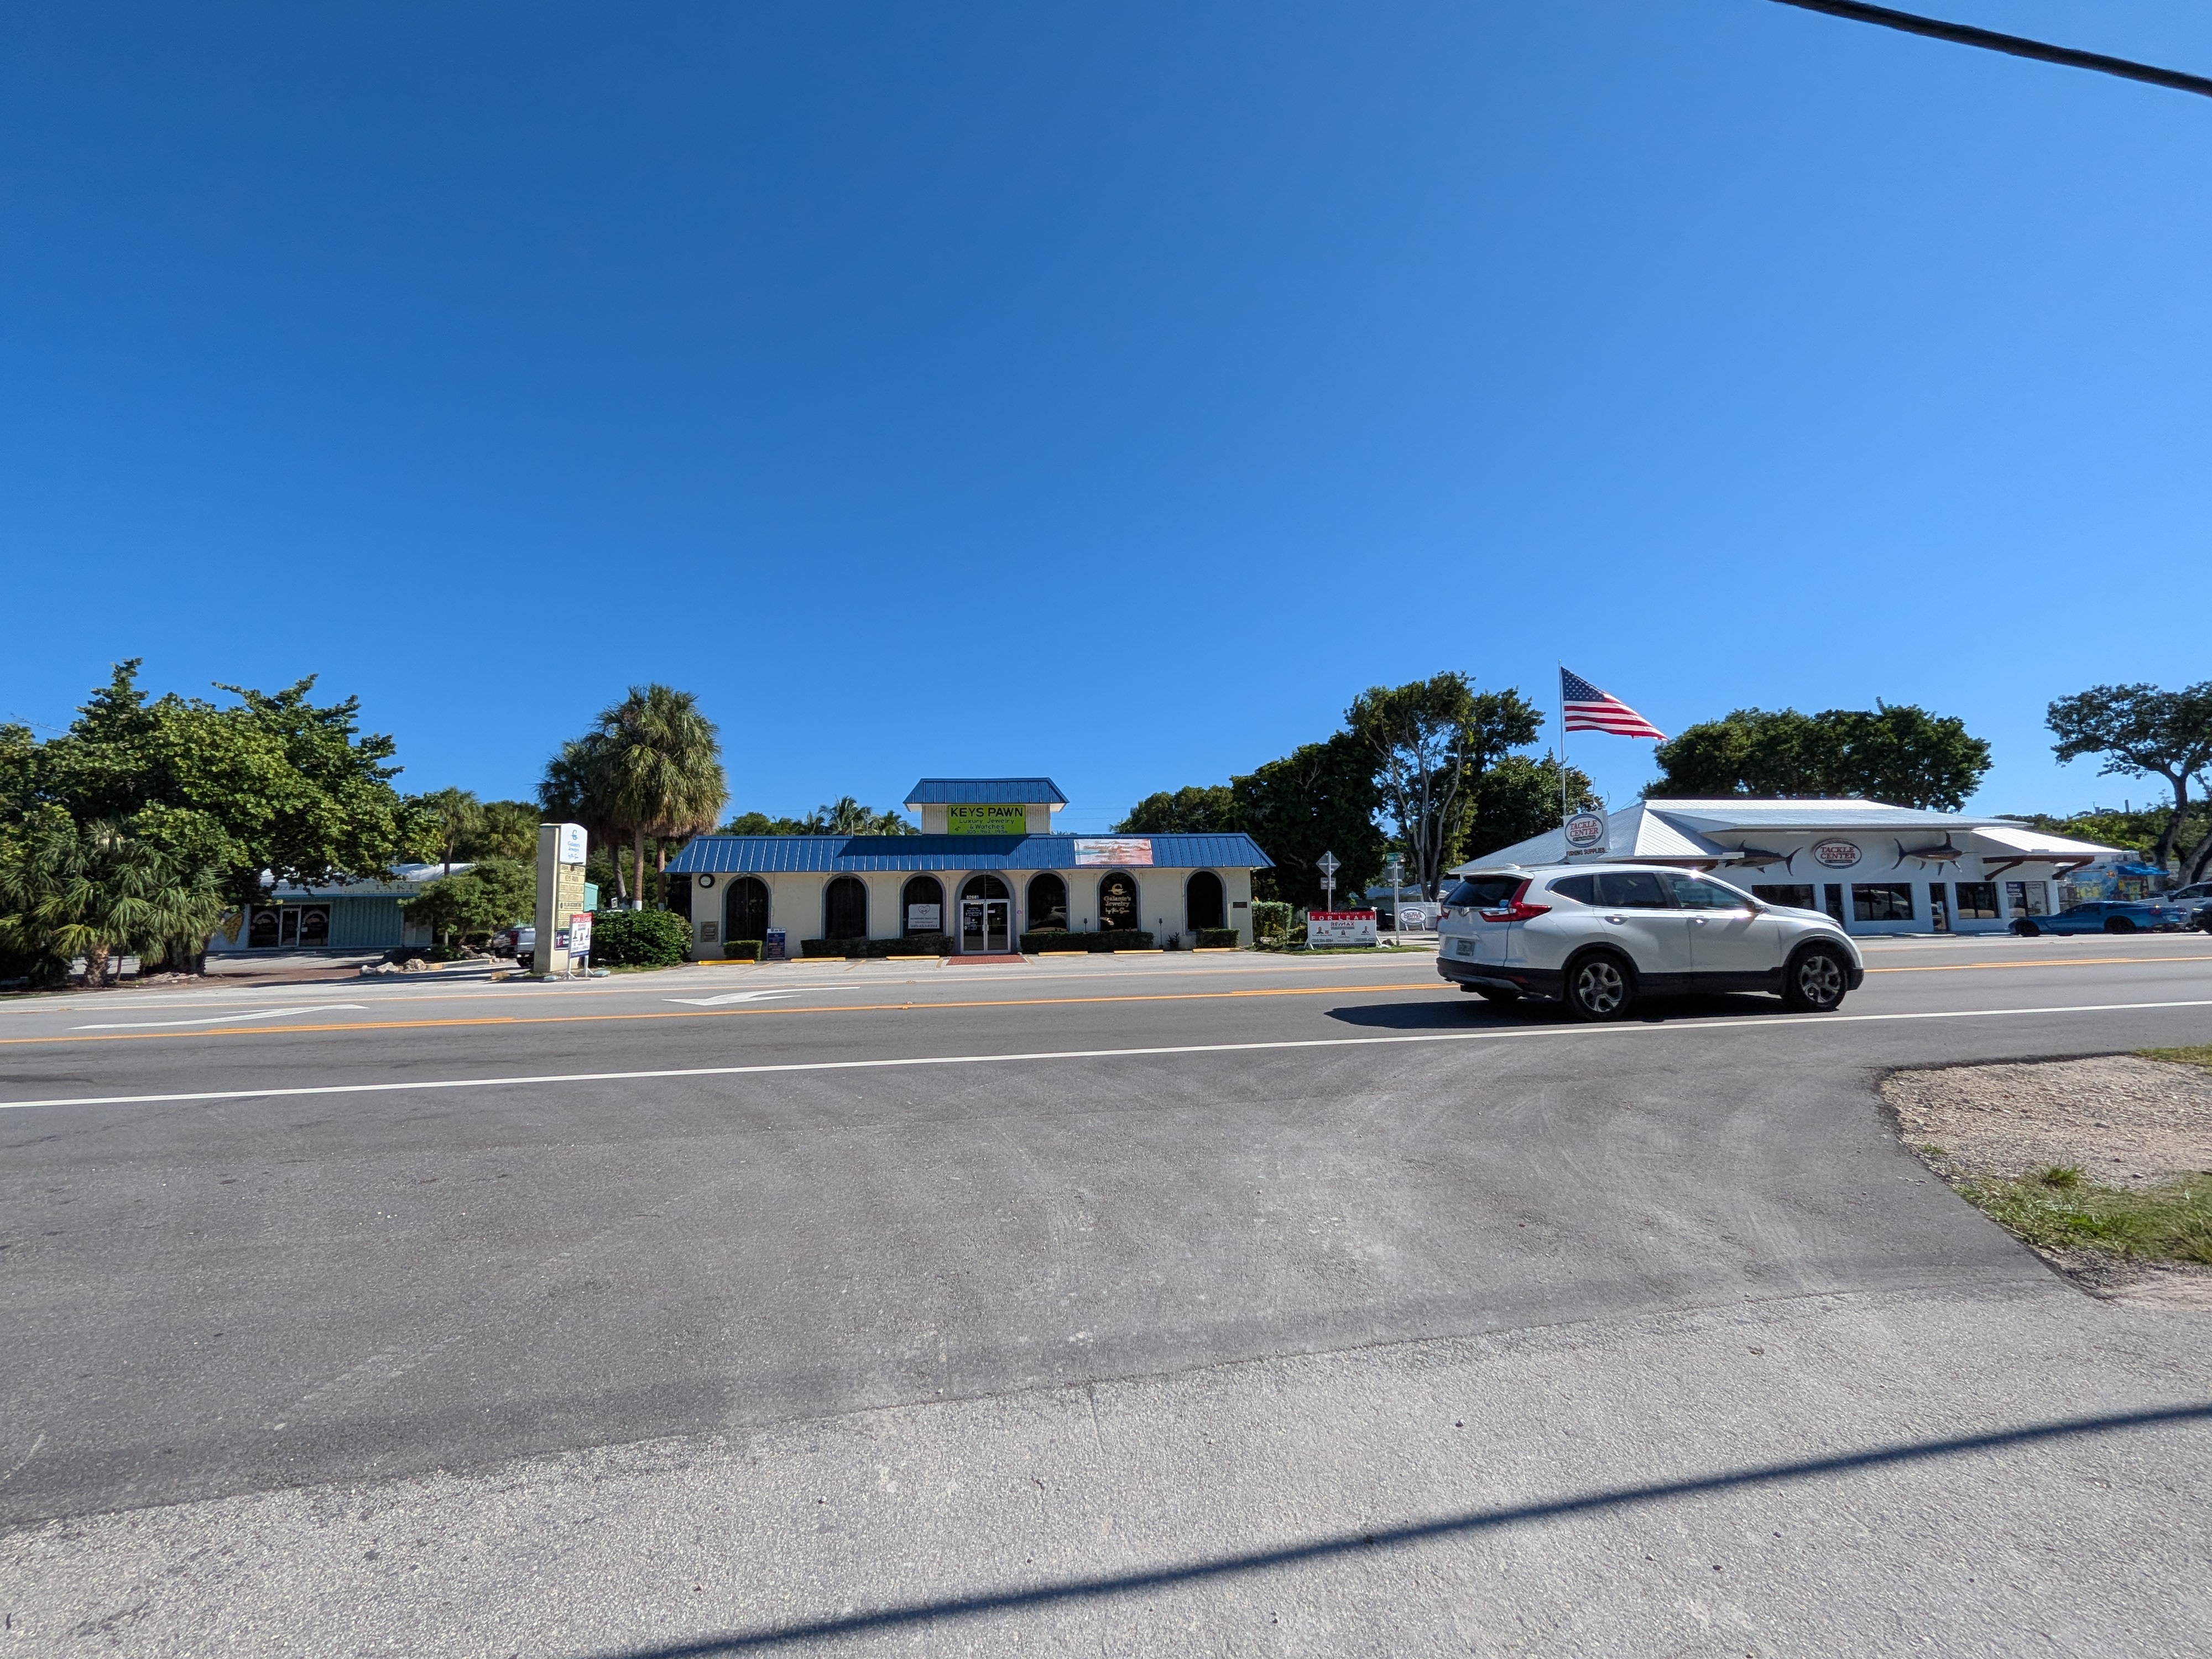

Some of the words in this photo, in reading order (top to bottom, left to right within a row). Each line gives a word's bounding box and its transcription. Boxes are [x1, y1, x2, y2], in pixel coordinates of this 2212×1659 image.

[951, 807, 984, 817] KEYS
[988, 807, 1023, 817] PAWN
[1570, 820, 1597, 830] TACKLE
[1570, 827, 1599, 837] CENTER
